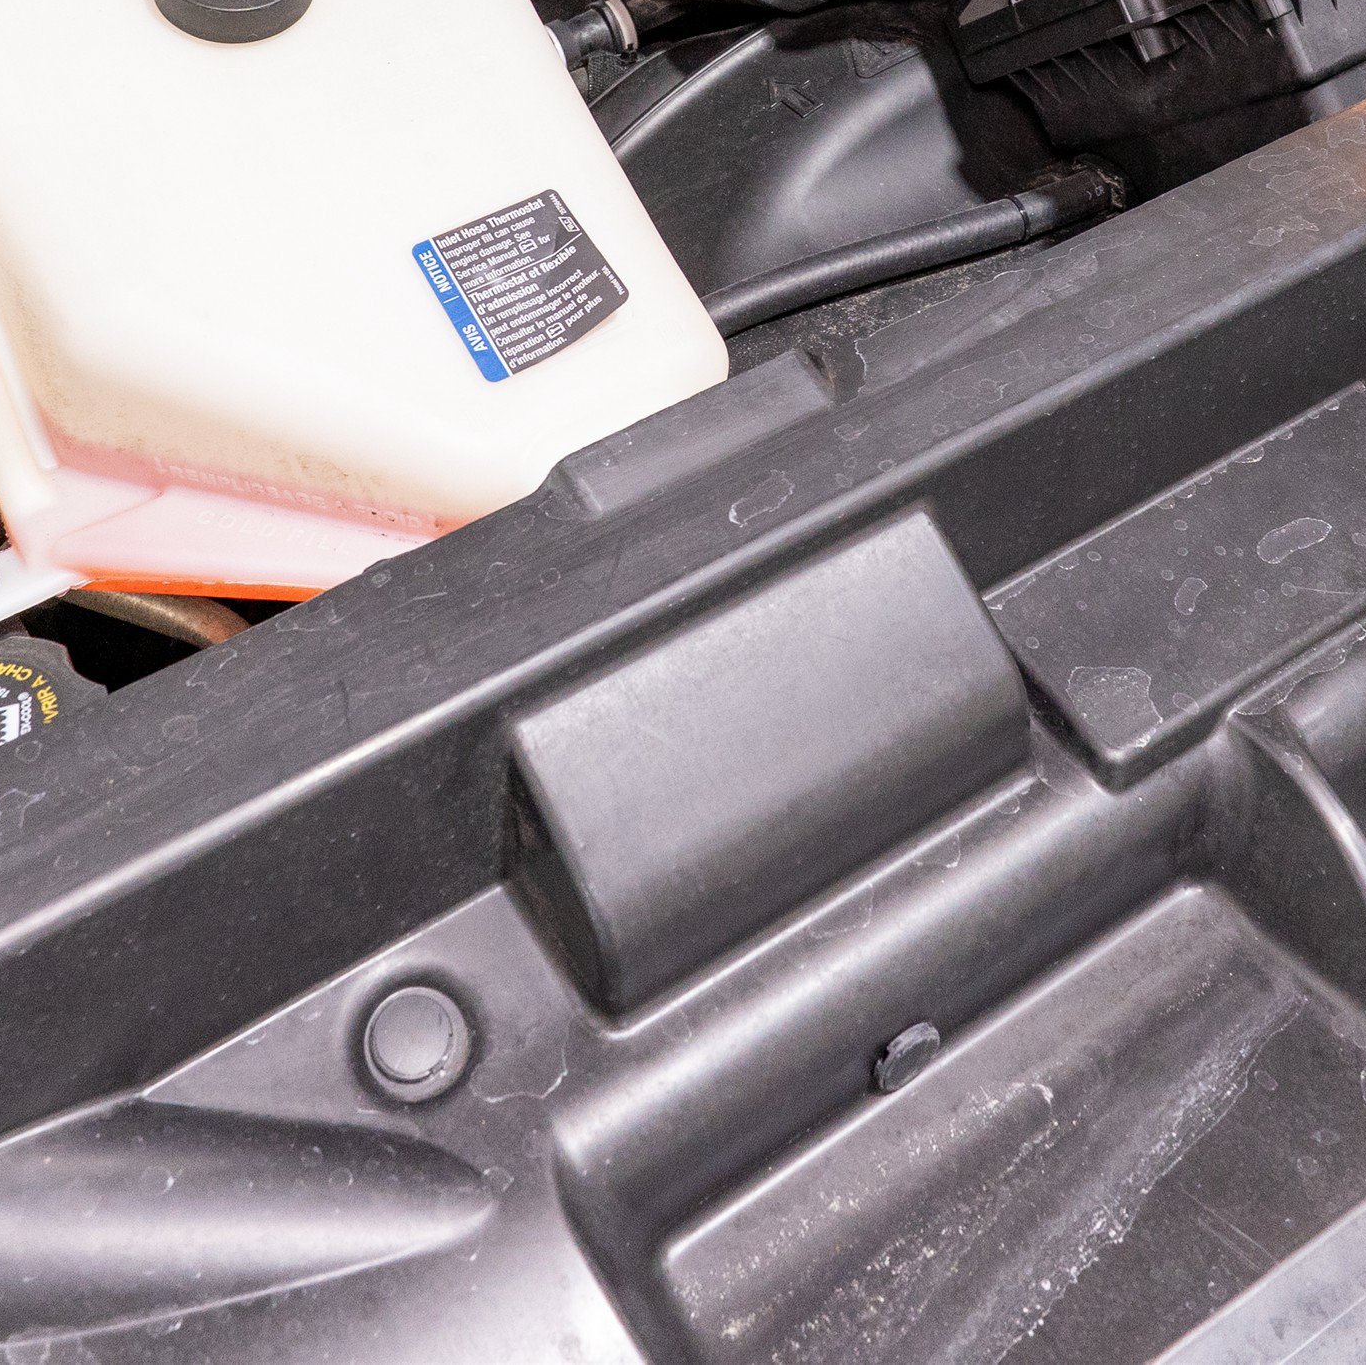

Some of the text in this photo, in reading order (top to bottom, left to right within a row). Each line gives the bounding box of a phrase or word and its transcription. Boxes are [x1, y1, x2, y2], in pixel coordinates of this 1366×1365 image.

[435, 197, 545, 249] Inlet Hose Thermostat
[442, 236, 484, 261] Improper
[509, 215, 536, 232] cause
[417, 249, 453, 293] NOTICE
[448, 251, 480, 271] engine
[477, 236, 515, 258] damage.
[454, 259, 488, 281] Service
[486, 246, 519, 267] Manual
[483, 252, 535, 282] information.
[467, 269, 529, 306] Thermostat
[537, 244, 580, 273] flexible
[494, 289, 548, 324] remplissage
[542, 268, 586, 297] incorrect
[474, 278, 540, 319] d'admission
[508, 295, 564, 331] endommager
[567, 269, 603, 294] moteur.
[563, 308, 587, 327] pour
[582, 294, 605, 313] plus
[461, 322, 489, 355] AVIS
[494, 320, 537, 350] Consulter
[543, 299, 579, 325] manuel
[37, 685, 59, 723] VRIR
